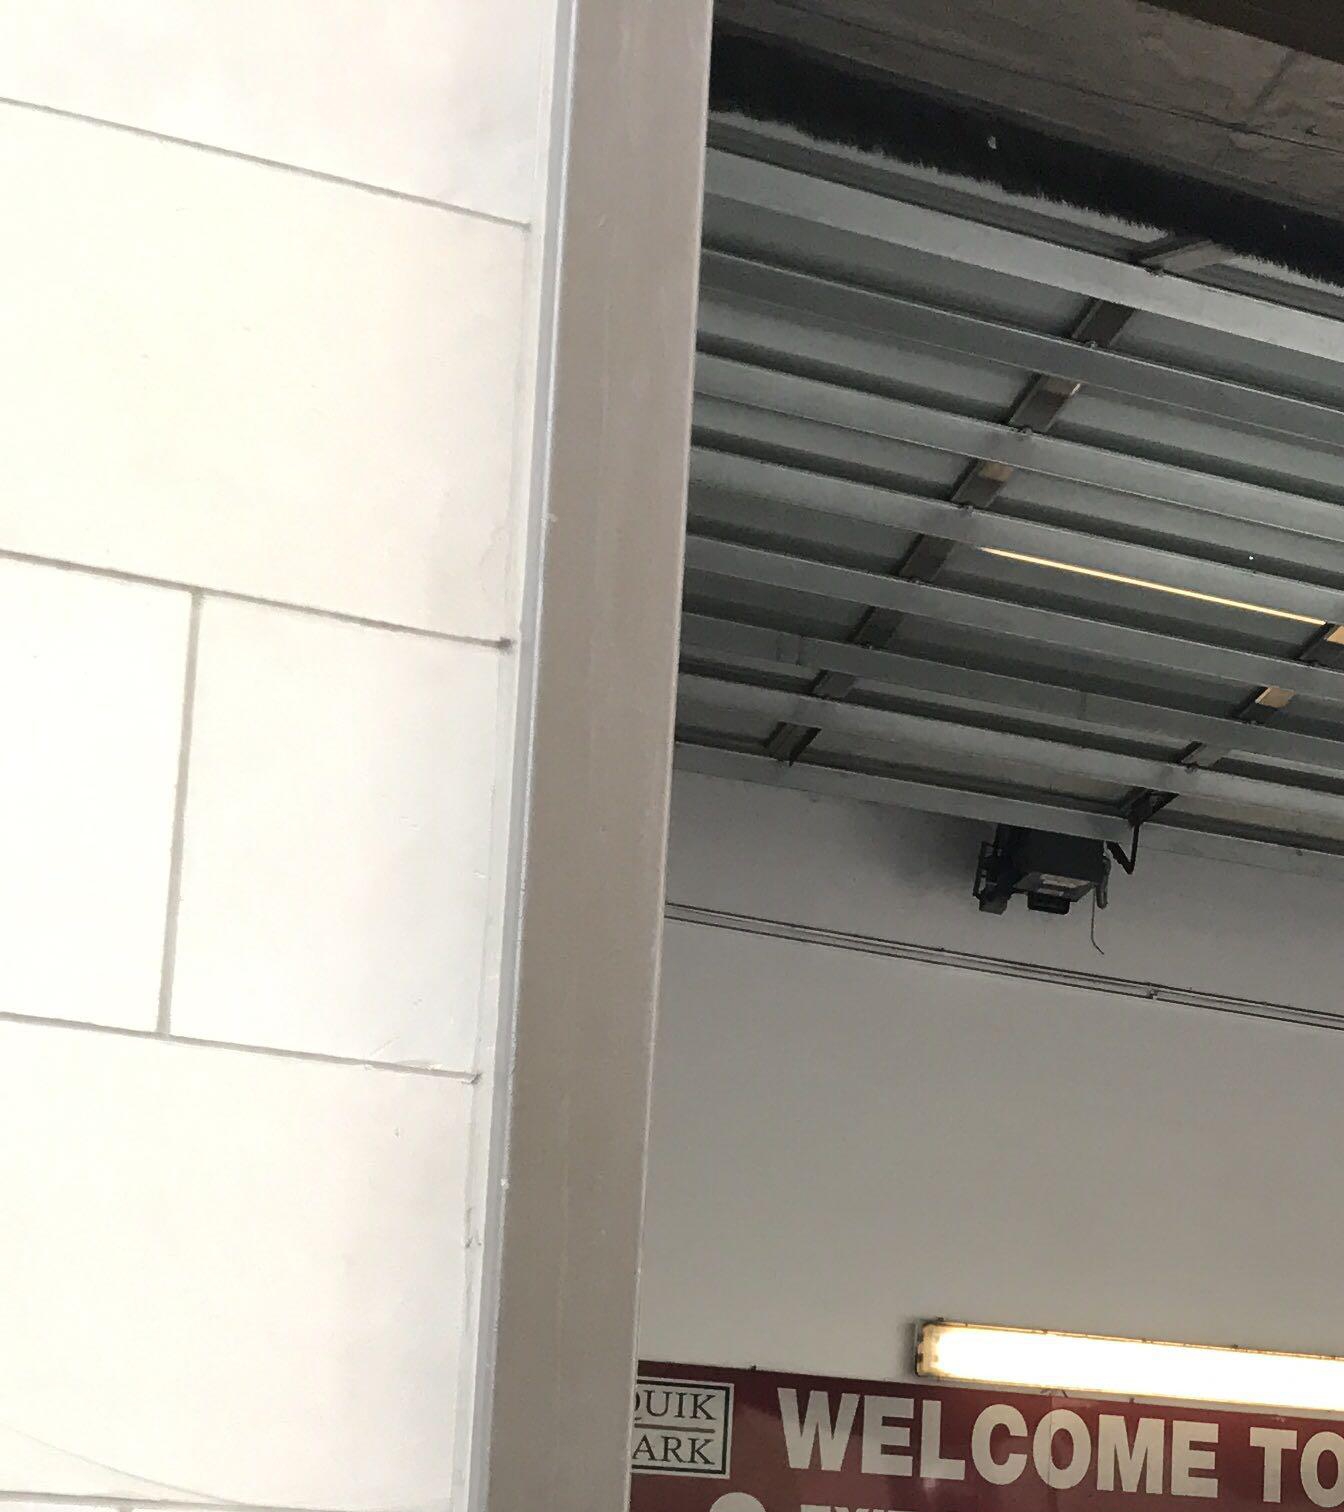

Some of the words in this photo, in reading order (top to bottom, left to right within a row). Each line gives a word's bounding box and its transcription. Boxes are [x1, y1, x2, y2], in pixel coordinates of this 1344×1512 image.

[634, 1389, 717, 1422] UIK
[632, 1433, 715, 1465] ARK
[777, 1387, 1219, 1499] WELCOME
